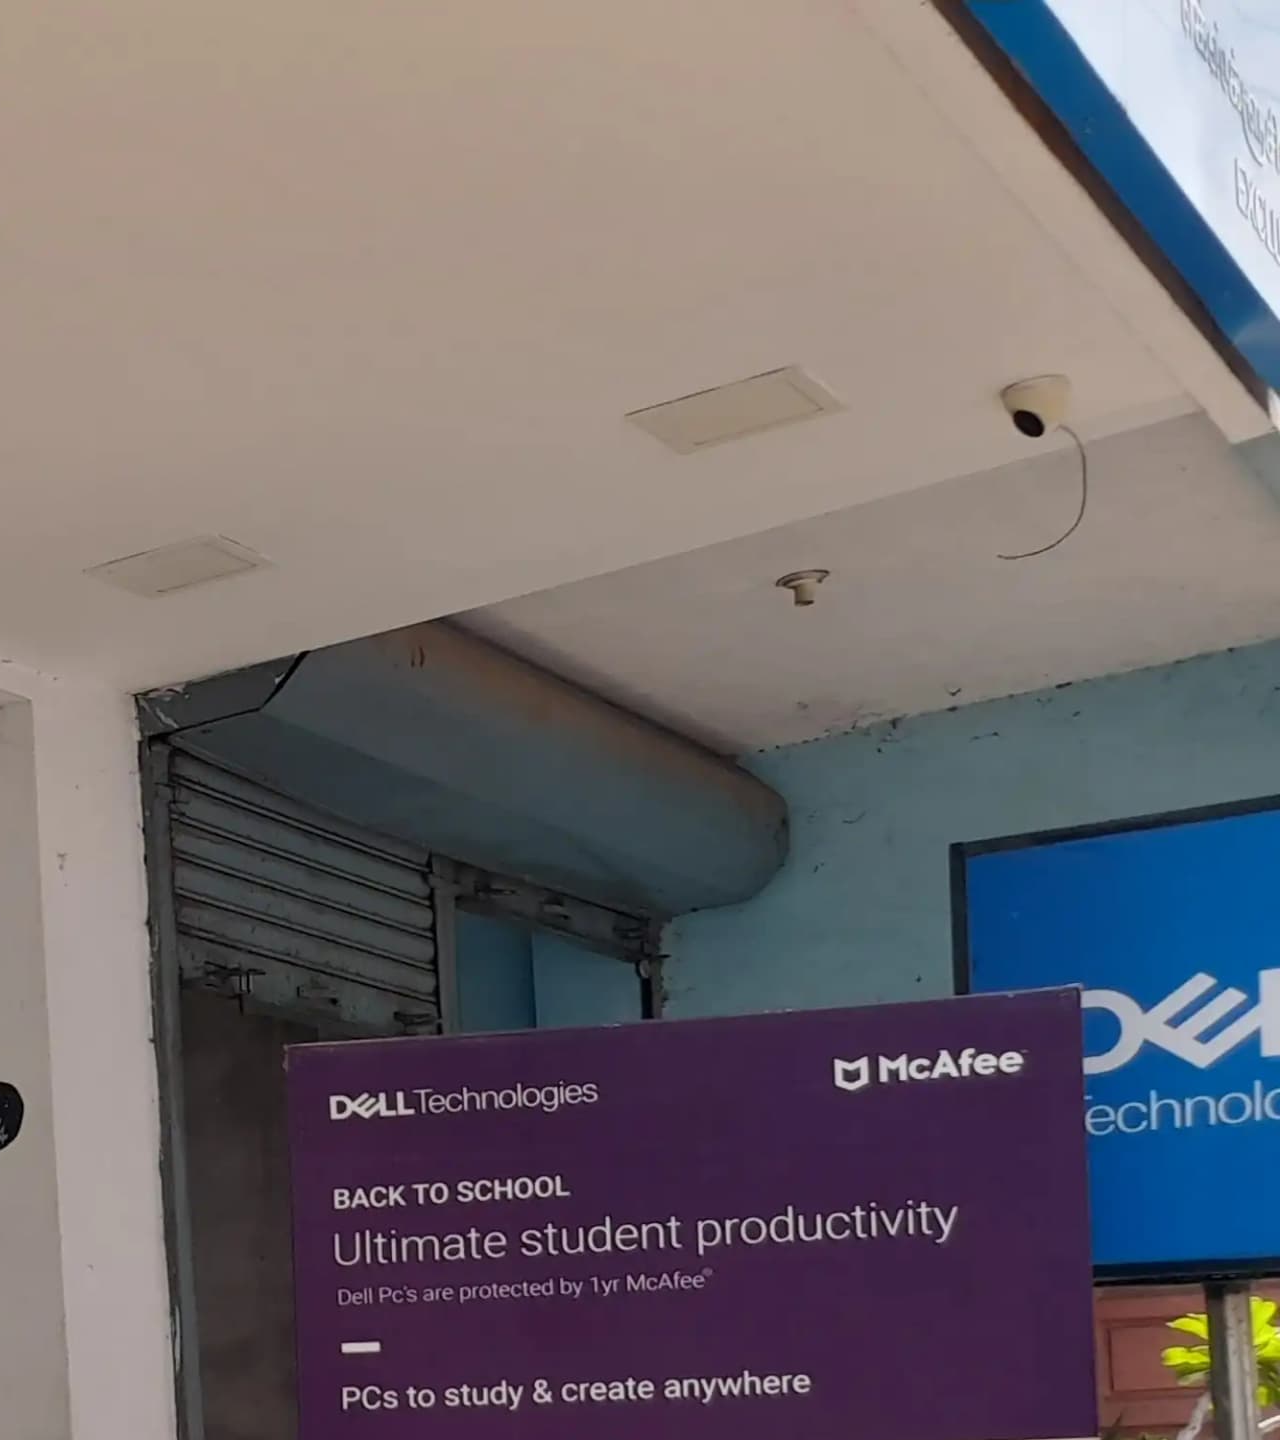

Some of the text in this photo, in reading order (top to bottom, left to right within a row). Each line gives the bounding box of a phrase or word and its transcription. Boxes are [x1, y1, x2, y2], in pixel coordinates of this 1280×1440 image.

[878, 1048, 1024, 1083] McAfee
[329, 1079, 598, 1121] DELL Technologies
[1082, 1079, 1280, 1137] echnol
[333, 1175, 571, 1210] BACK TO SCHOOL
[334, 1199, 959, 1266] Ultimate student productivity
[338, 1284, 374, 1306] Dell
[423, 1285, 455, 1302] are
[459, 1274, 555, 1304] protected
[560, 1275, 583, 1299] by
[590, 1274, 621, 1297] 1yr
[341, 1369, 812, 1411] PCs to study & create anywhere
